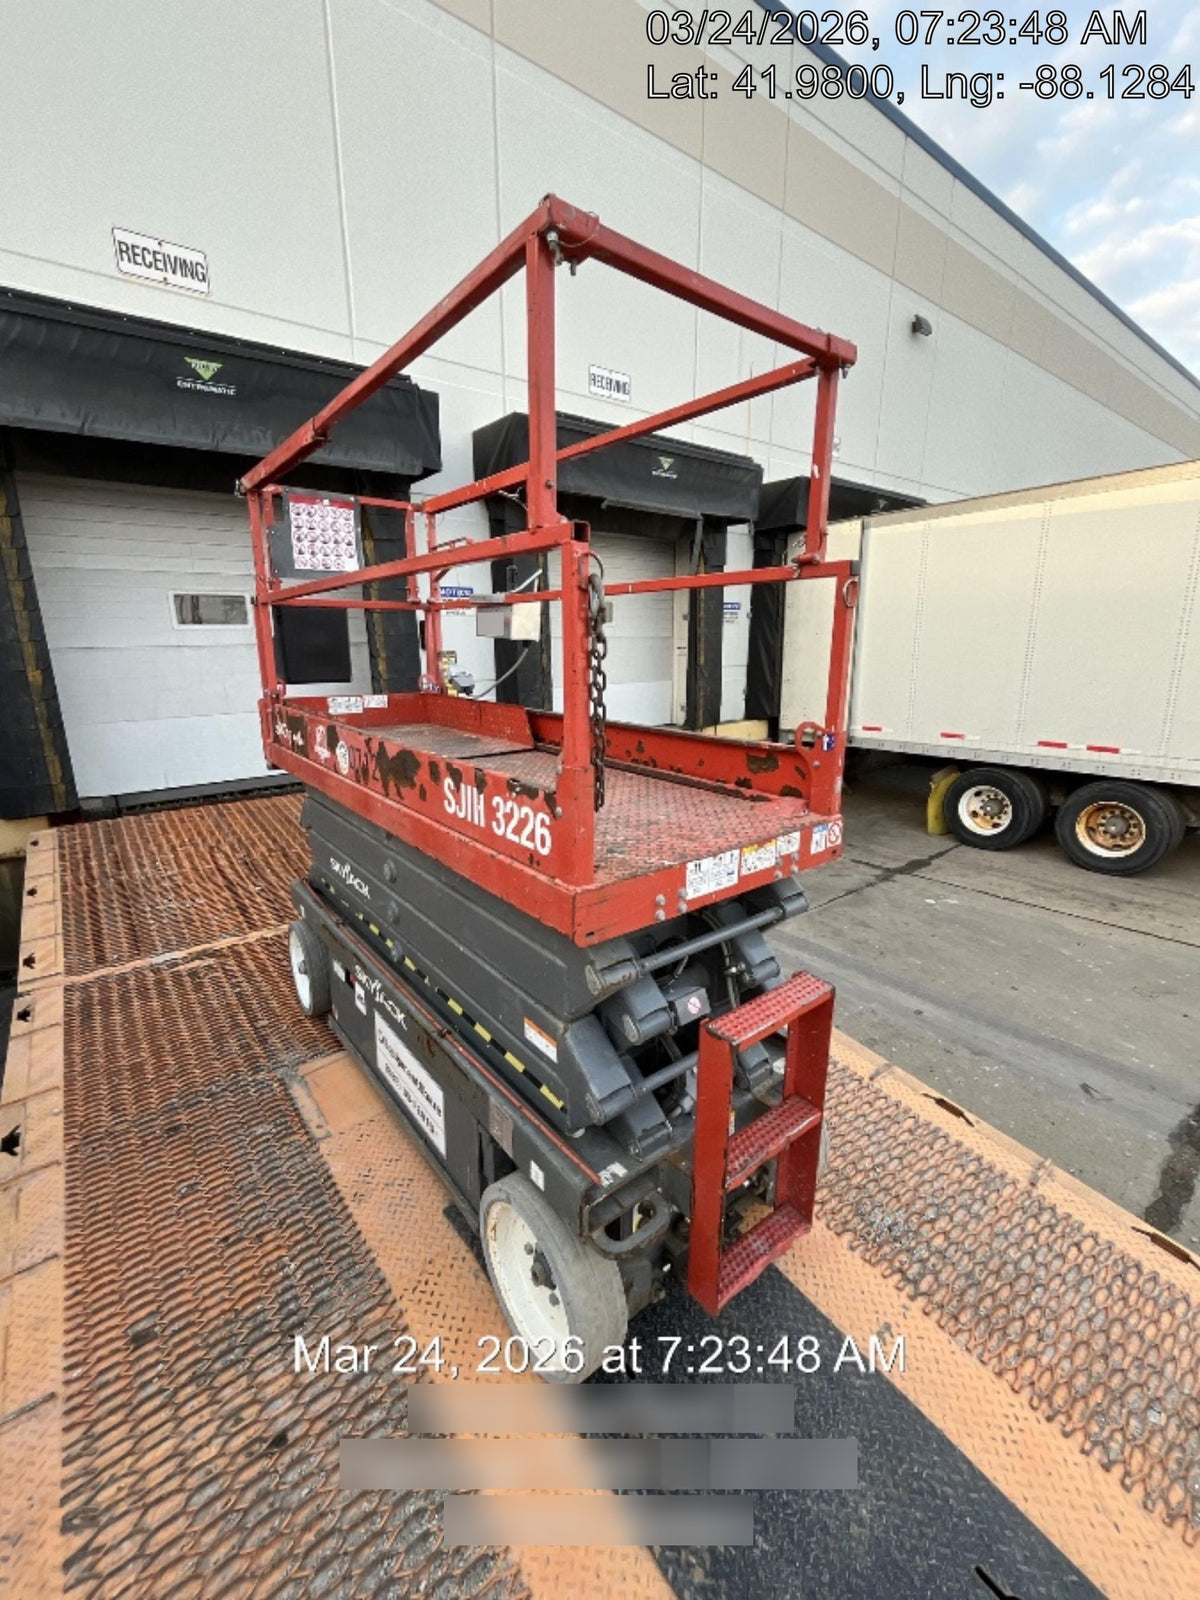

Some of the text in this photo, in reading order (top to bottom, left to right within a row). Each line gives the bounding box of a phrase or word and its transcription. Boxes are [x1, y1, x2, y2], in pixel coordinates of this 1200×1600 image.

[117, 239, 206, 283] RECEIVING
[590, 372, 630, 395] RECEIVING
[491, 795, 552, 856] 3226
